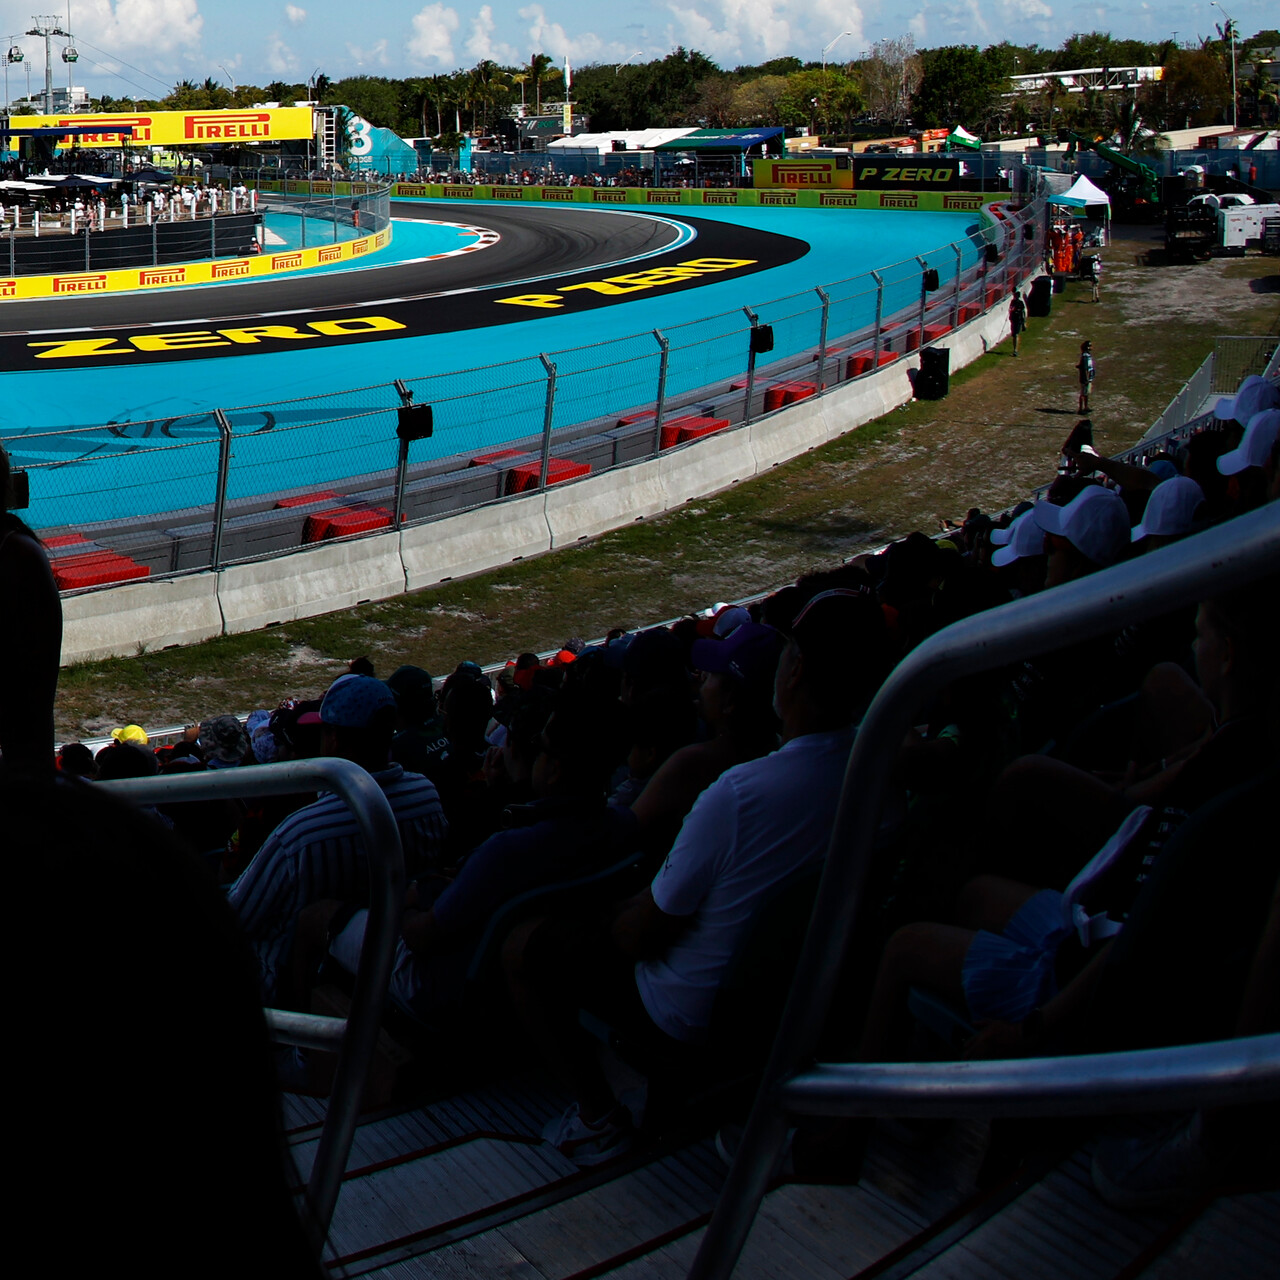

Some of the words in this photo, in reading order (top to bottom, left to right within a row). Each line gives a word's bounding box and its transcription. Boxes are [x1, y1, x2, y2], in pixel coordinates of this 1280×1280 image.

[185, 113, 270, 138] PIRELLI
[772, 164, 832, 184] PIRELLI
[860, 168, 876, 181] P
[882, 168, 953, 182] ZERO
[397, 185, 426, 196] PIRELLI
[444, 186, 473, 197] PIRELLI
[492, 188, 522, 198] PIRELLI
[542, 189, 573, 200] PIRELLI
[594, 190, 626, 202] PIRELLI
[647, 191, 681, 202] PIRELLI
[703, 192, 737, 204] PIRELLI
[760, 192, 797, 204] PIRELLI
[820, 193, 857, 206] PIRELLI
[880, 194, 918, 207] PIRELLI
[943, 195, 983, 209] PIRELLI
[318, 246, 341, 262] PIRELLI
[353, 240, 368, 255] PIRELLI
[272, 253, 302, 269] PIRELLI
[212, 261, 249, 277] PIRELLI
[53, 275, 106, 292] PIRELLI
[140, 268, 185, 285] PIRELLI
[493, 293, 565, 308] P
[556, 257, 759, 295] ZERO
[26, 316, 407, 358] ZERO
